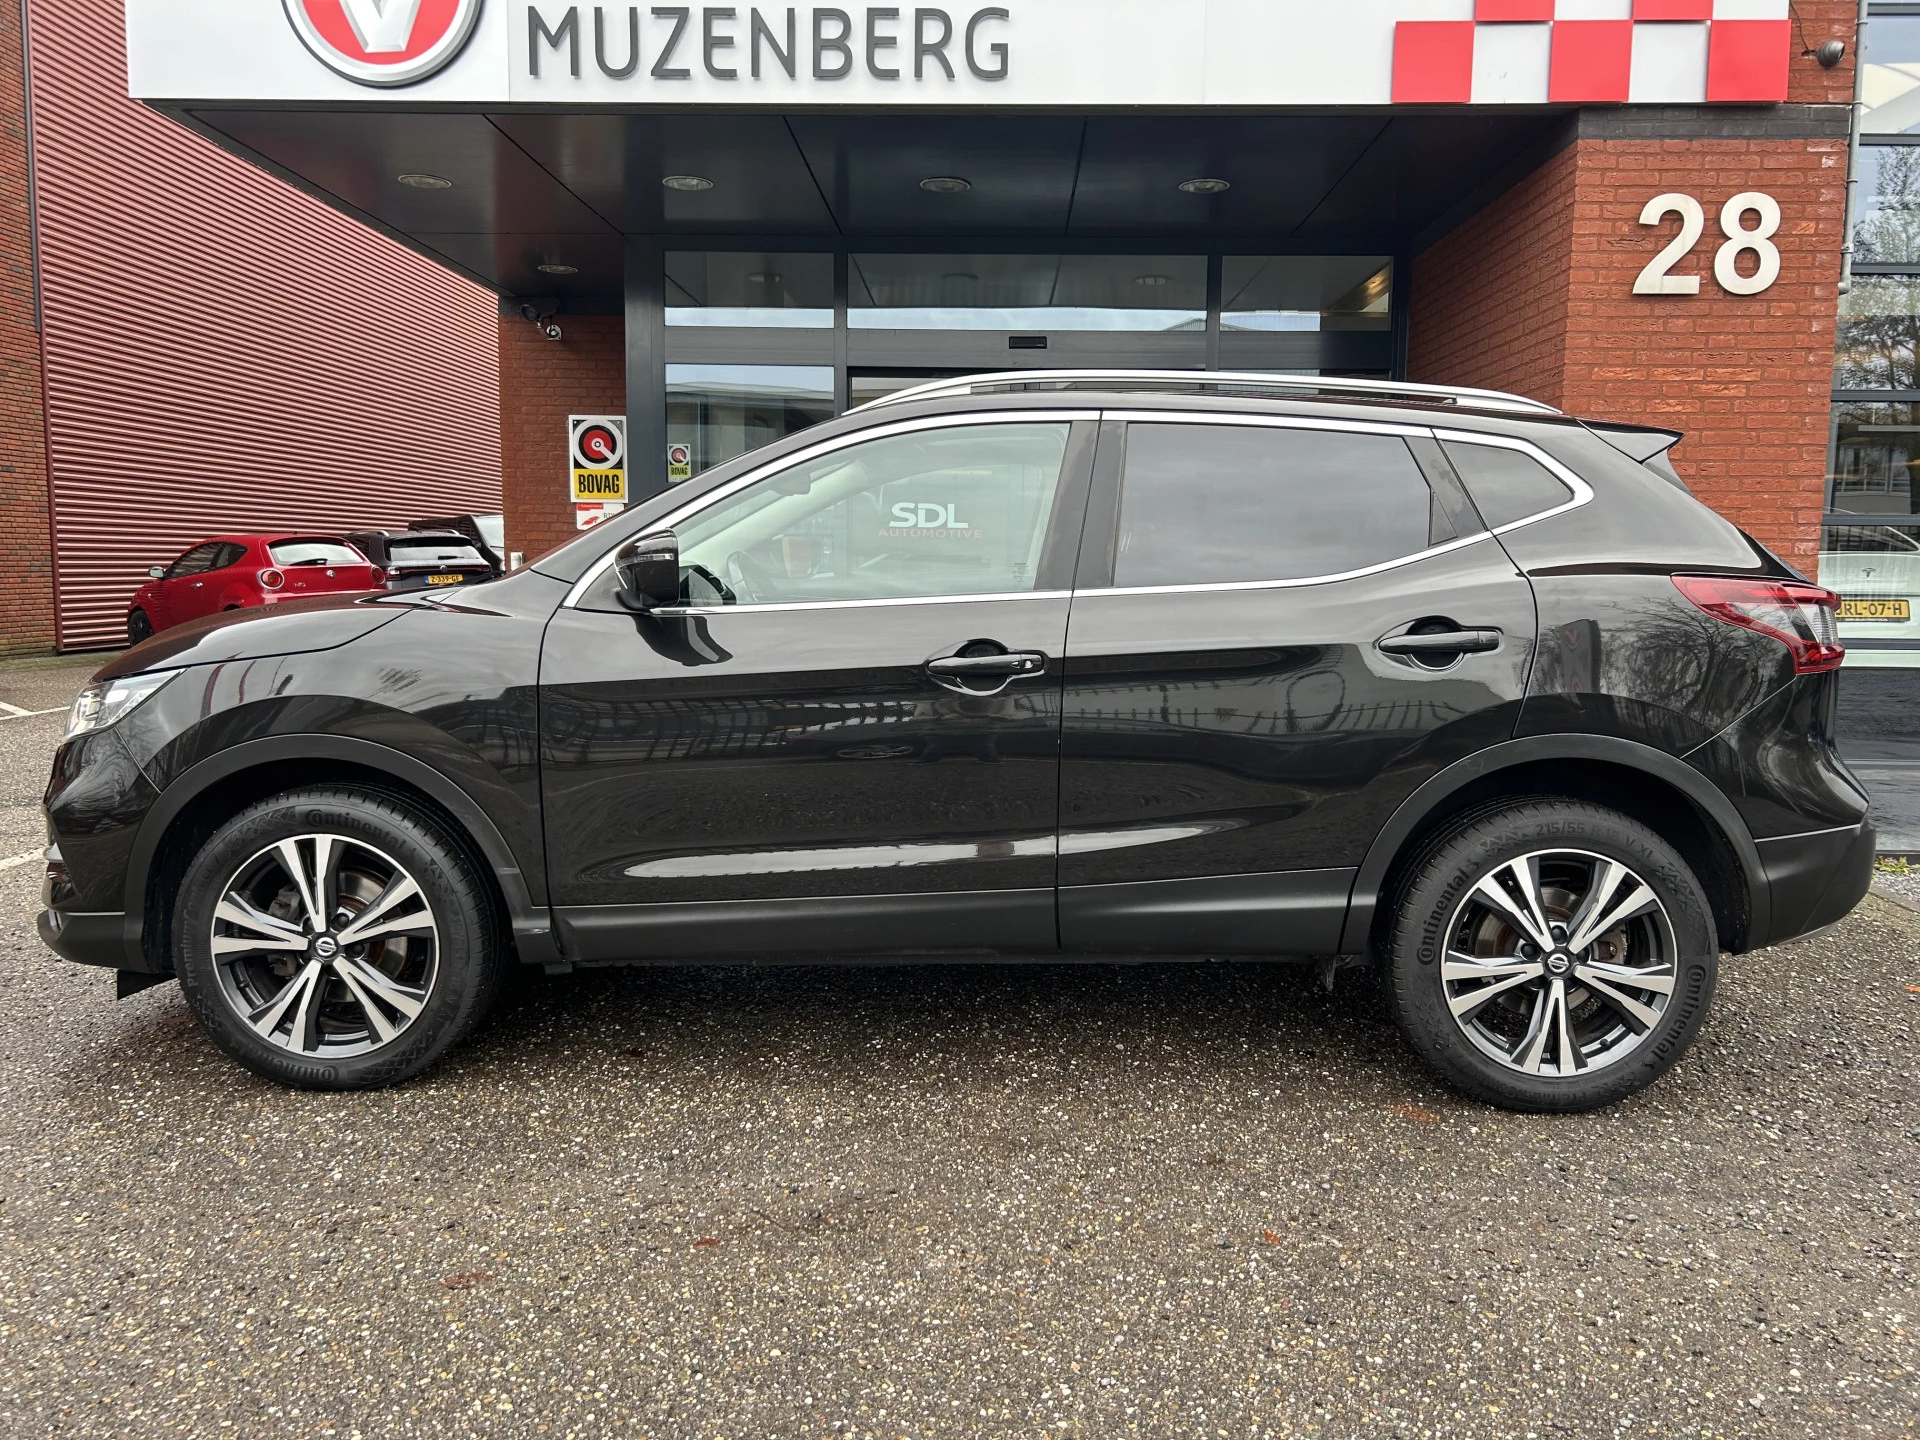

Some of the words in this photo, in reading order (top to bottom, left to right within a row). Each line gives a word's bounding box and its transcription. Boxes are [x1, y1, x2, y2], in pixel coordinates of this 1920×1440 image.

[527, 5, 1011, 79] MUZENBERG
[1632, 192, 1781, 296] 28
[578, 474, 620, 494] BOVAG
[671, 467, 688, 475] BOVAG
[889, 502, 969, 528] SDL
[878, 528, 983, 538] AUTOMOTIVE
[305, 808, 407, 848] Continental
[1535, 820, 1585, 836] 215/55
[1416, 871, 1471, 966] Continental
[1656, 963, 1708, 1063] Continental
